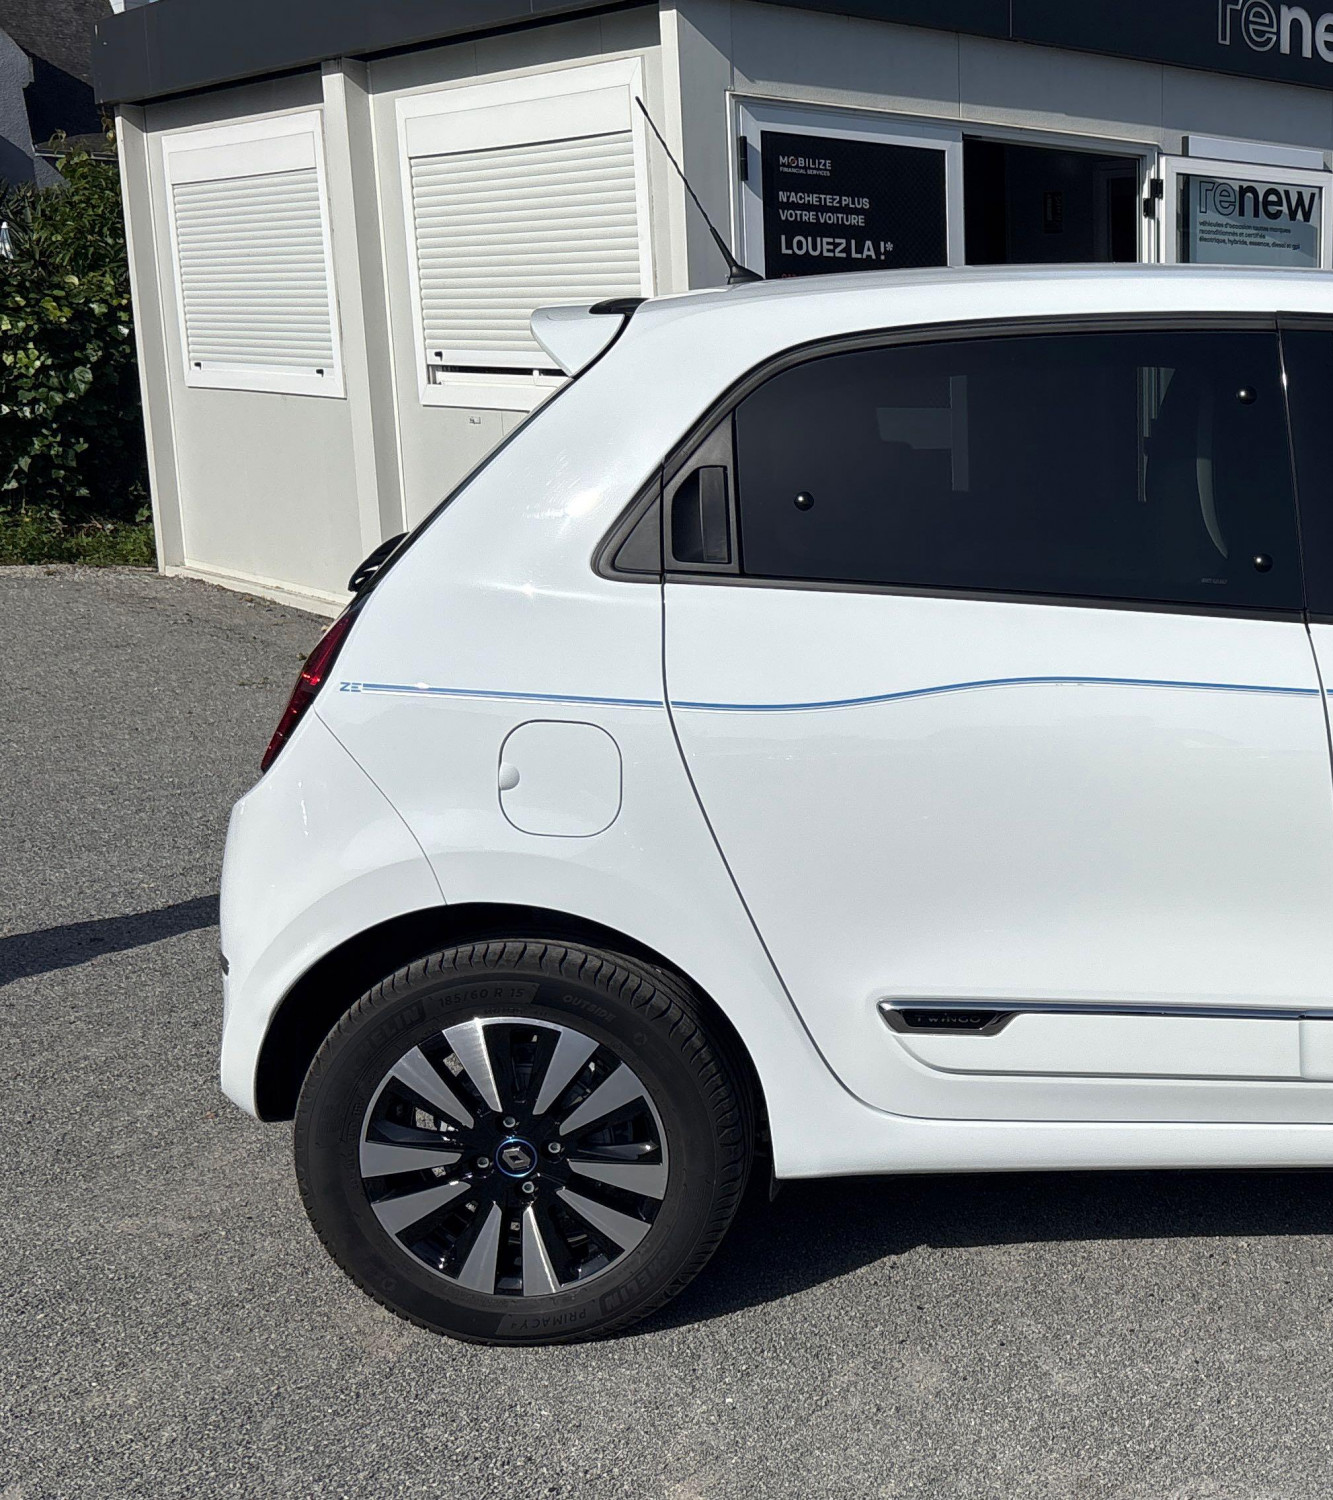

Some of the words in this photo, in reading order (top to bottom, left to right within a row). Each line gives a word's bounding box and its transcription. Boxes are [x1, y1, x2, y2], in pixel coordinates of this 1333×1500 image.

[779, 155, 832, 170] MOBILIZE
[780, 167, 806, 175] FINANCIAL
[807, 168, 830, 177] SERVICES
[778, 191, 840, 207] N'ACHETEZ
[841, 195, 870, 209] PLUS
[1199, 180, 1316, 222] renew
[779, 209, 817, 223] VOTRE
[818, 212, 865, 226] VOITURE
[780, 234, 847, 258] LOUEZ
[851, 239, 876, 260] LA
[440, 988, 489, 1008] 185/60
[494, 987, 503, 998] R
[510, 988, 525, 998] 15
[519, 1308, 587, 1330] PRIMACY
